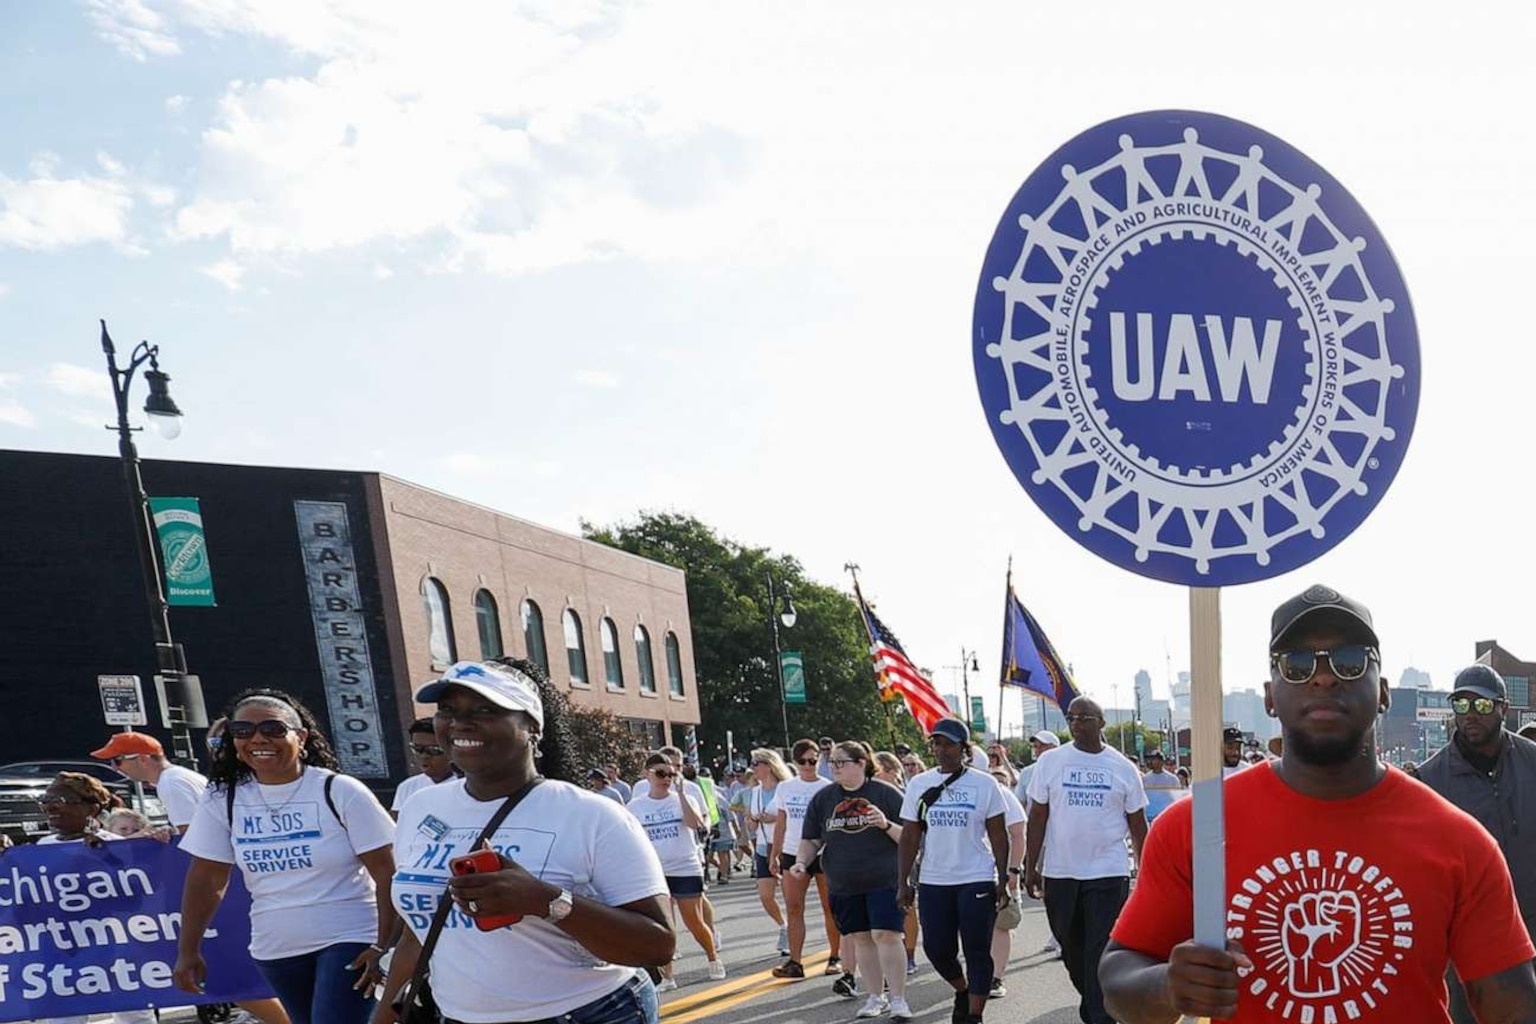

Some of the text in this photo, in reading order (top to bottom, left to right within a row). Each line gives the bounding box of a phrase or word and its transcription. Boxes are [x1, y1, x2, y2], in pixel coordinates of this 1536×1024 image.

[1056, 203, 1338, 487] UNITED AUTOMOBILE, AEROSPACE AND AGRICULTURAL IMPLEMENT WORKERS OF AMERICA
[1109, 311, 1283, 404] UAW
[169, 587, 211, 596] Discover
[313, 522, 371, 757] BARBERSHOP
[1069, 772, 1105, 784] MI SOS
[949, 791, 968, 802] SOS
[1067, 790, 1105, 799] SERVICE
[1068, 799, 1103, 808] DRIVEN
[928, 811, 969, 819] SERVICE
[243, 812, 304, 834] MI SOS
[930, 818, 968, 828] DRIVEN
[647, 825, 679, 836] SERVICE
[649, 832, 679, 841] DRIVEN
[242, 844, 312, 862] SERVICE
[413, 843, 456, 871] MI
[246, 857, 313, 873] DRIVEN
[1227, 849, 1413, 948] STRONGER TOGETHER
[22, 958, 174, 1000] State
